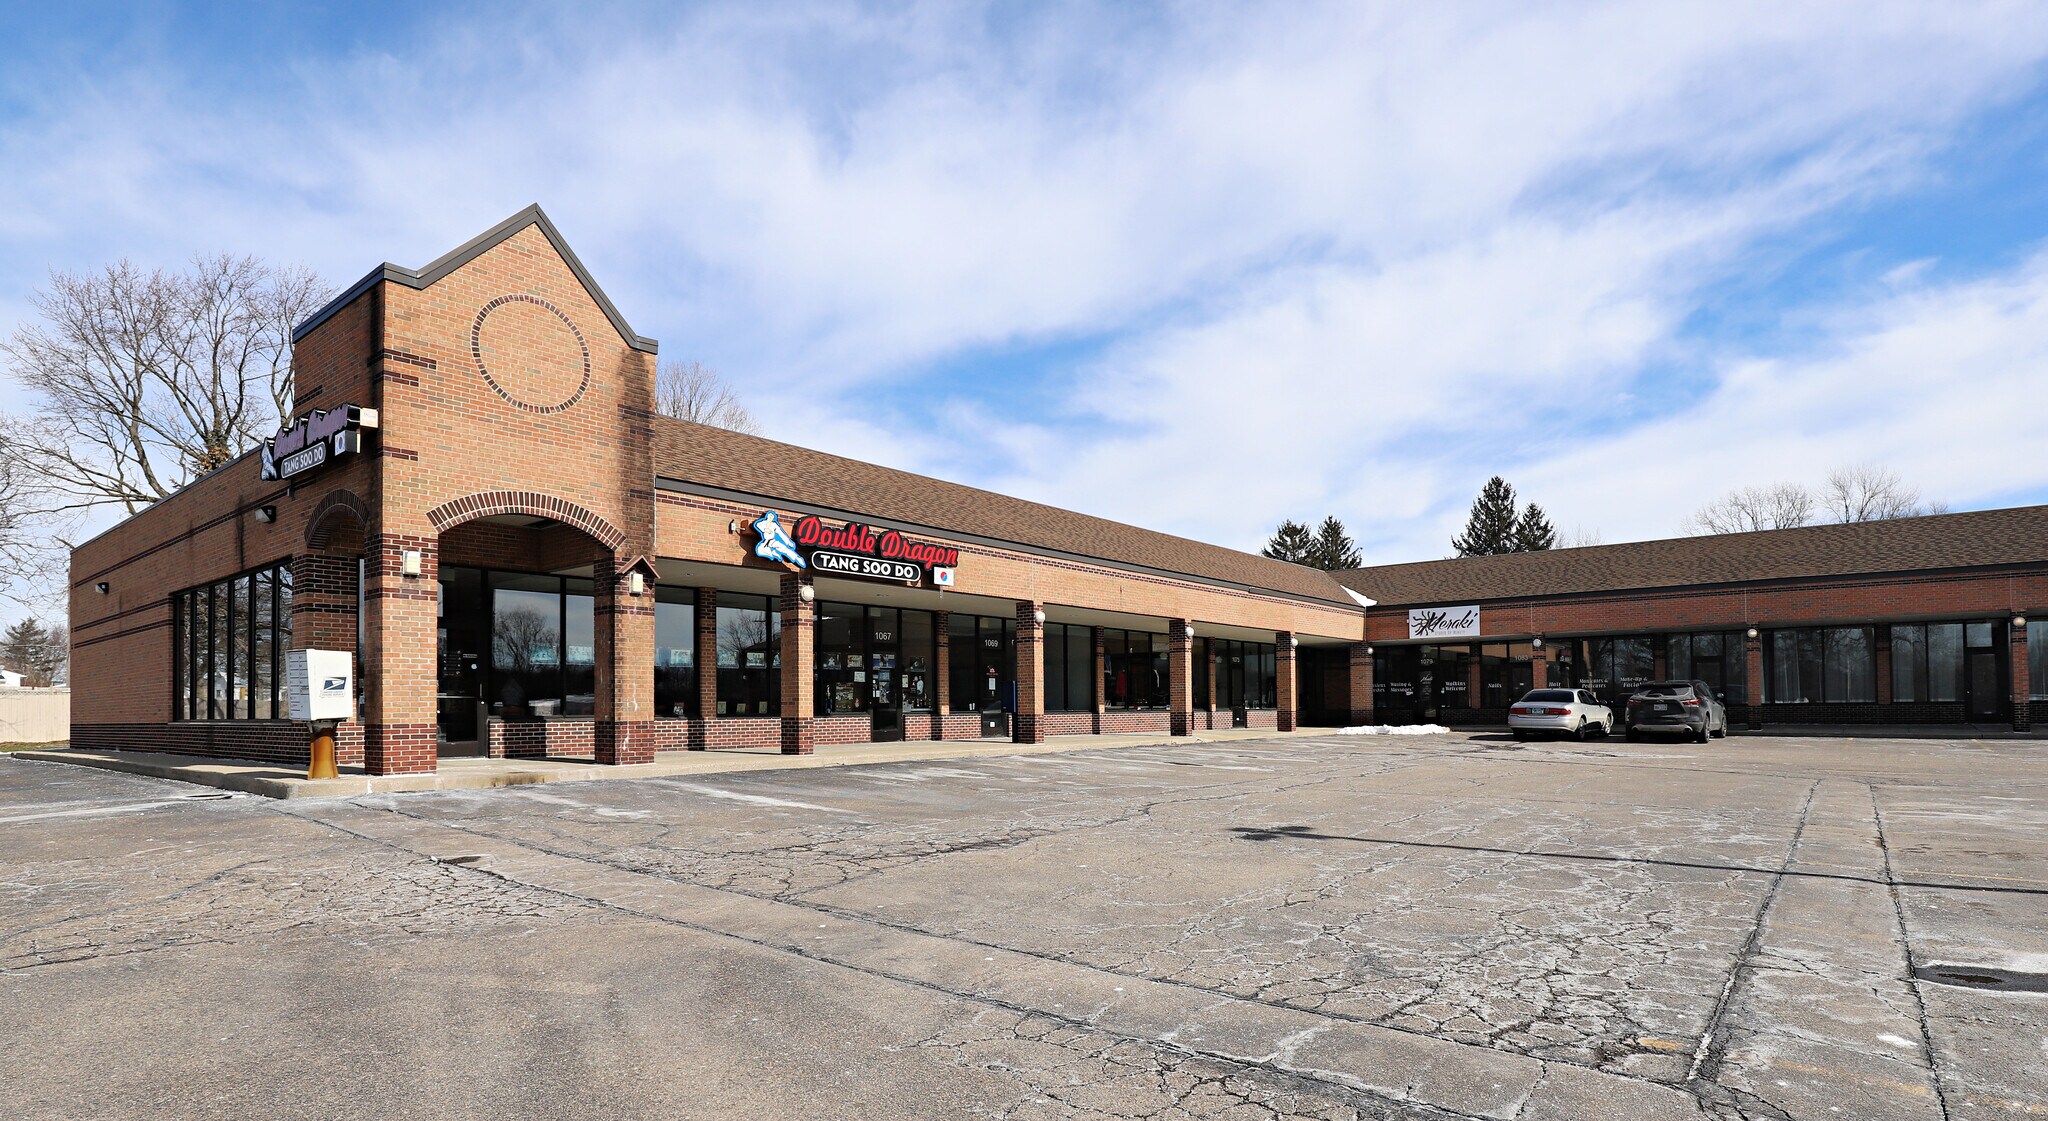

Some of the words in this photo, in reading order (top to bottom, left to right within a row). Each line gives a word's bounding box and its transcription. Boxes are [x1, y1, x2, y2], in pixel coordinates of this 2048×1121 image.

[283, 458, 299, 473] TANG
[300, 451, 312, 468] SOO
[314, 447, 323, 461] DO
[799, 516, 875, 551] Double
[881, 531, 958, 569] Dragon
[820, 554, 859, 572] TANG
[863, 560, 891, 576] SOO
[895, 565, 914, 579] DO
[875, 632, 892, 640] 1067
[984, 639, 998, 648] 1069
